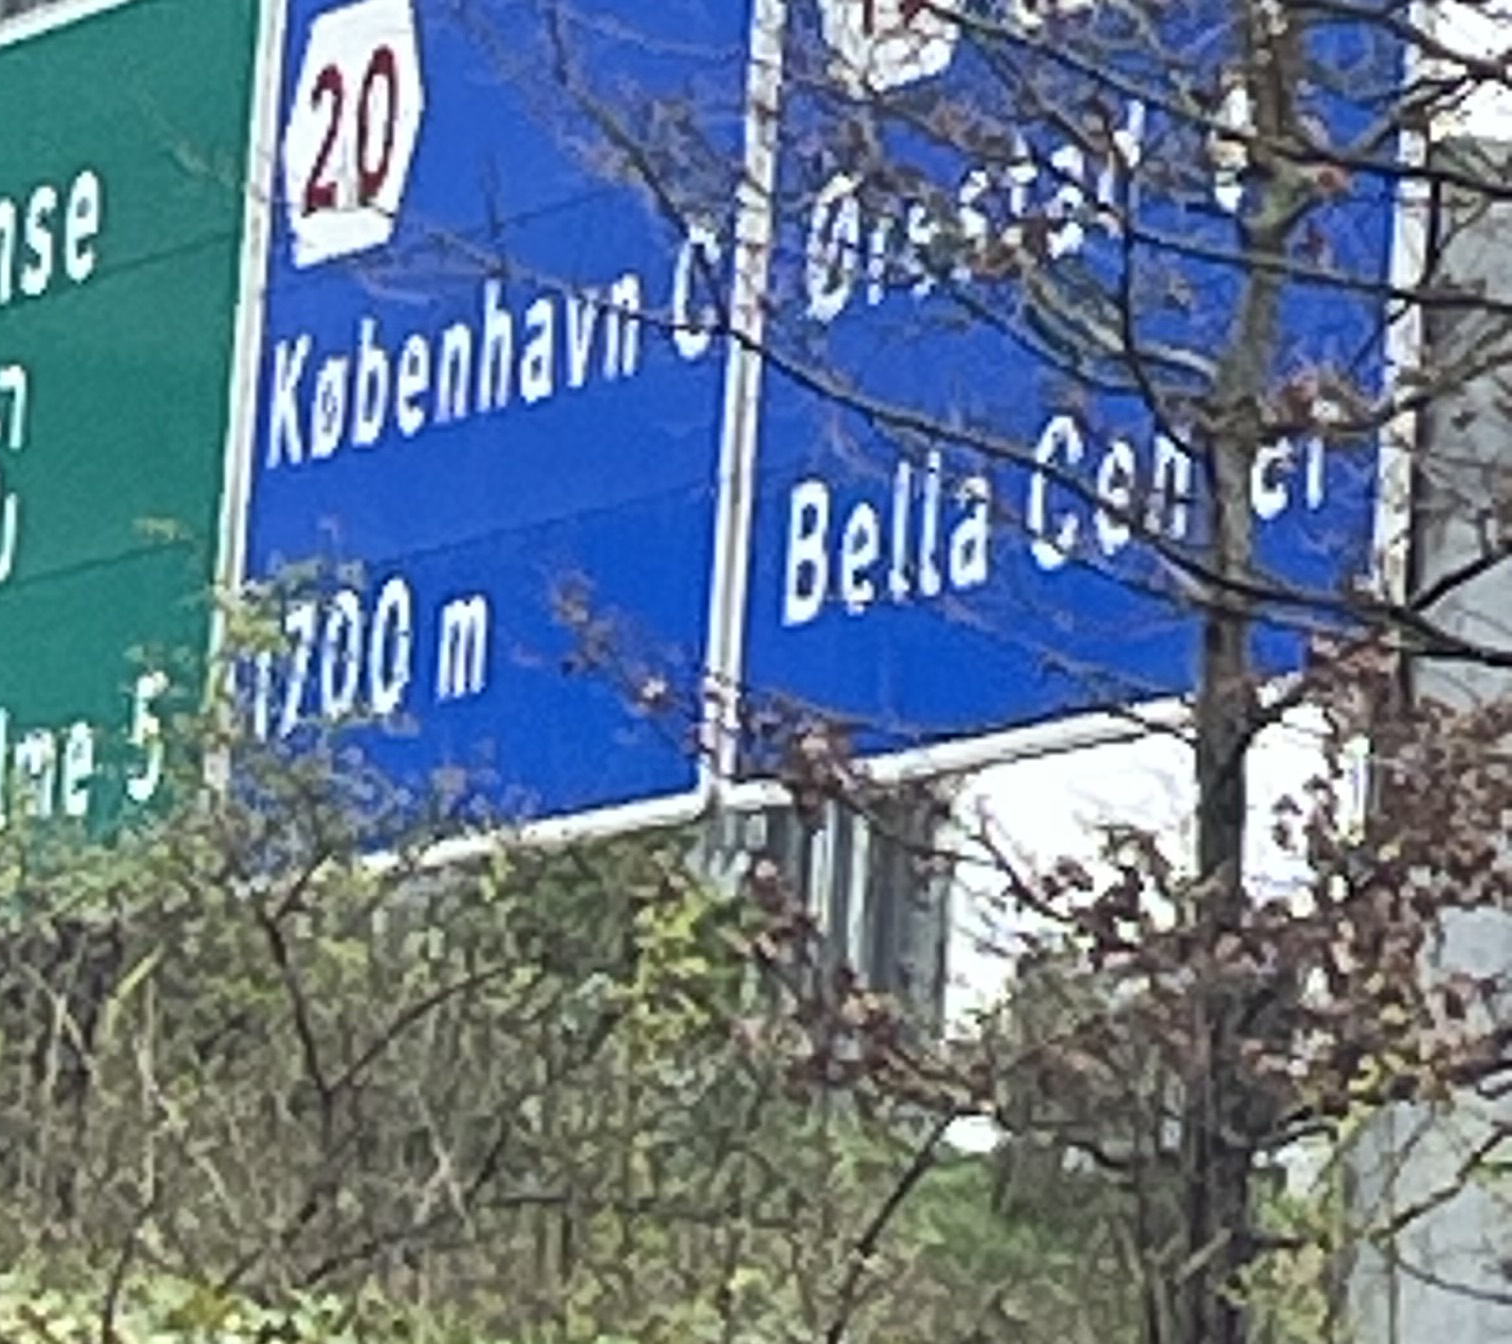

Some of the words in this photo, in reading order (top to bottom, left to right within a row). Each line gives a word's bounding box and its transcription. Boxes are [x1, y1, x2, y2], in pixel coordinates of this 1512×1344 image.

[302, 45, 400, 211] 20
[266, 274, 642, 470] København
[673, 220, 722, 361] C
[782, 450, 990, 628] Bella
[1027, 414, 1326, 571] Cener
[437, 594, 487, 701] m
